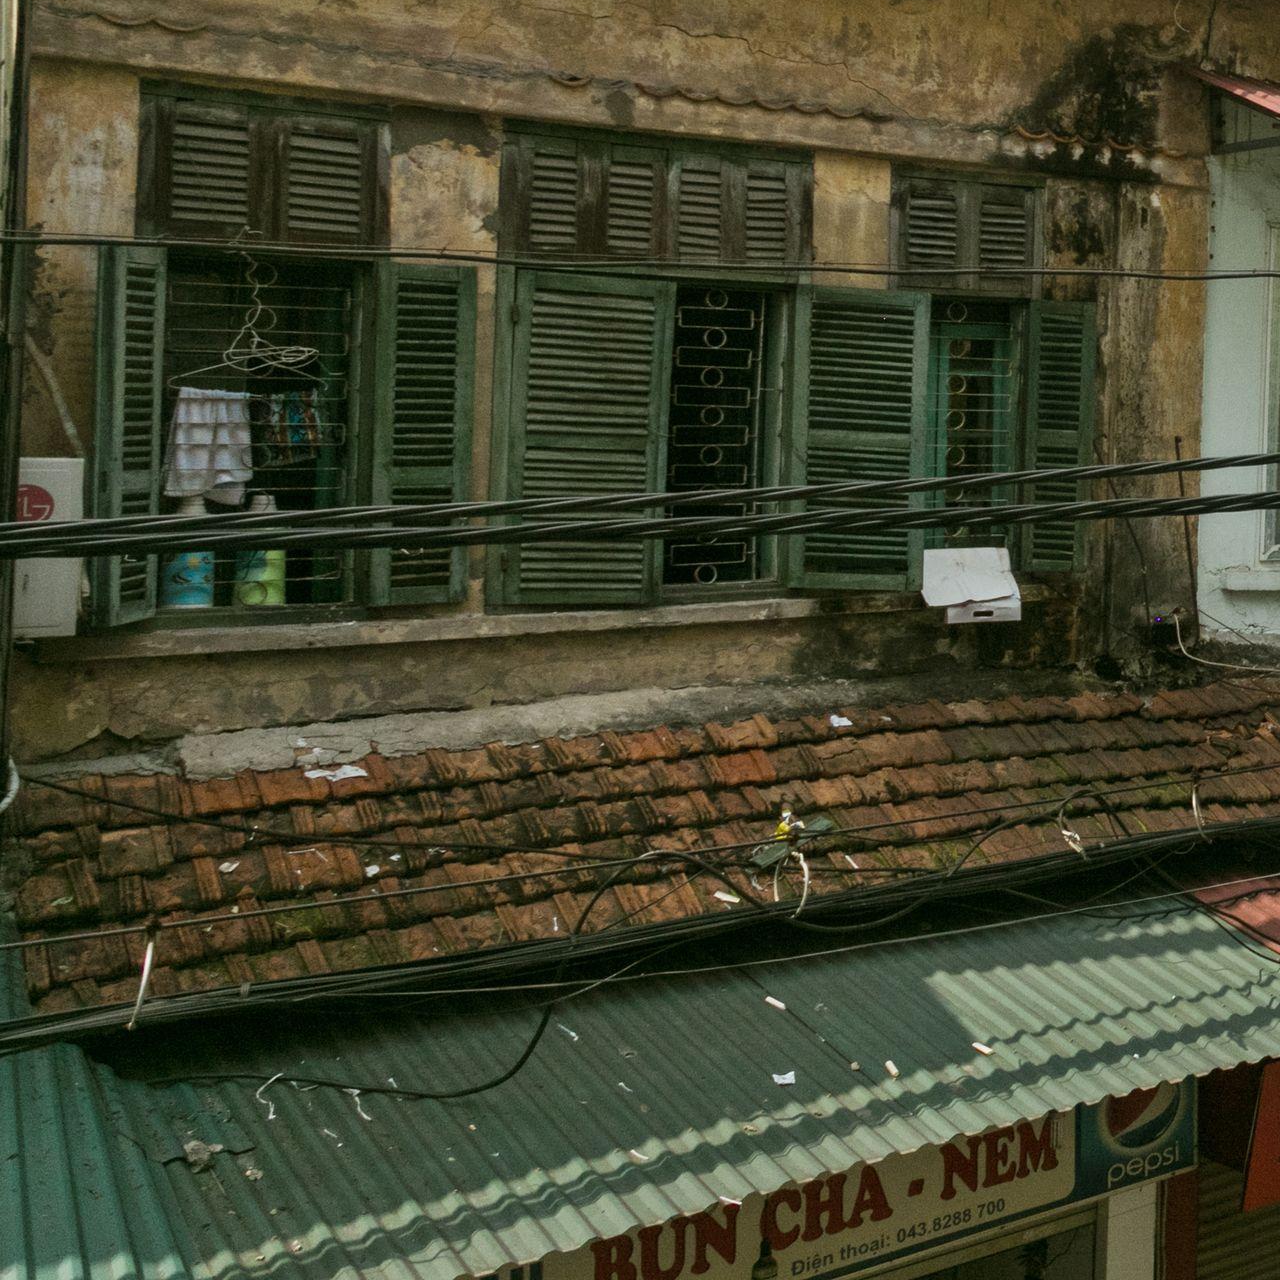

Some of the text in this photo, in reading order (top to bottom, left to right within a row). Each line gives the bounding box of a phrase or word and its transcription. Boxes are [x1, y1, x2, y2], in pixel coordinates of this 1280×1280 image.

[940, 1113, 1059, 1200] NEM
[1107, 1142, 1179, 1189] pepsi
[791, 1198, 1006, 1277] Điện thoại: 043.8288 700
